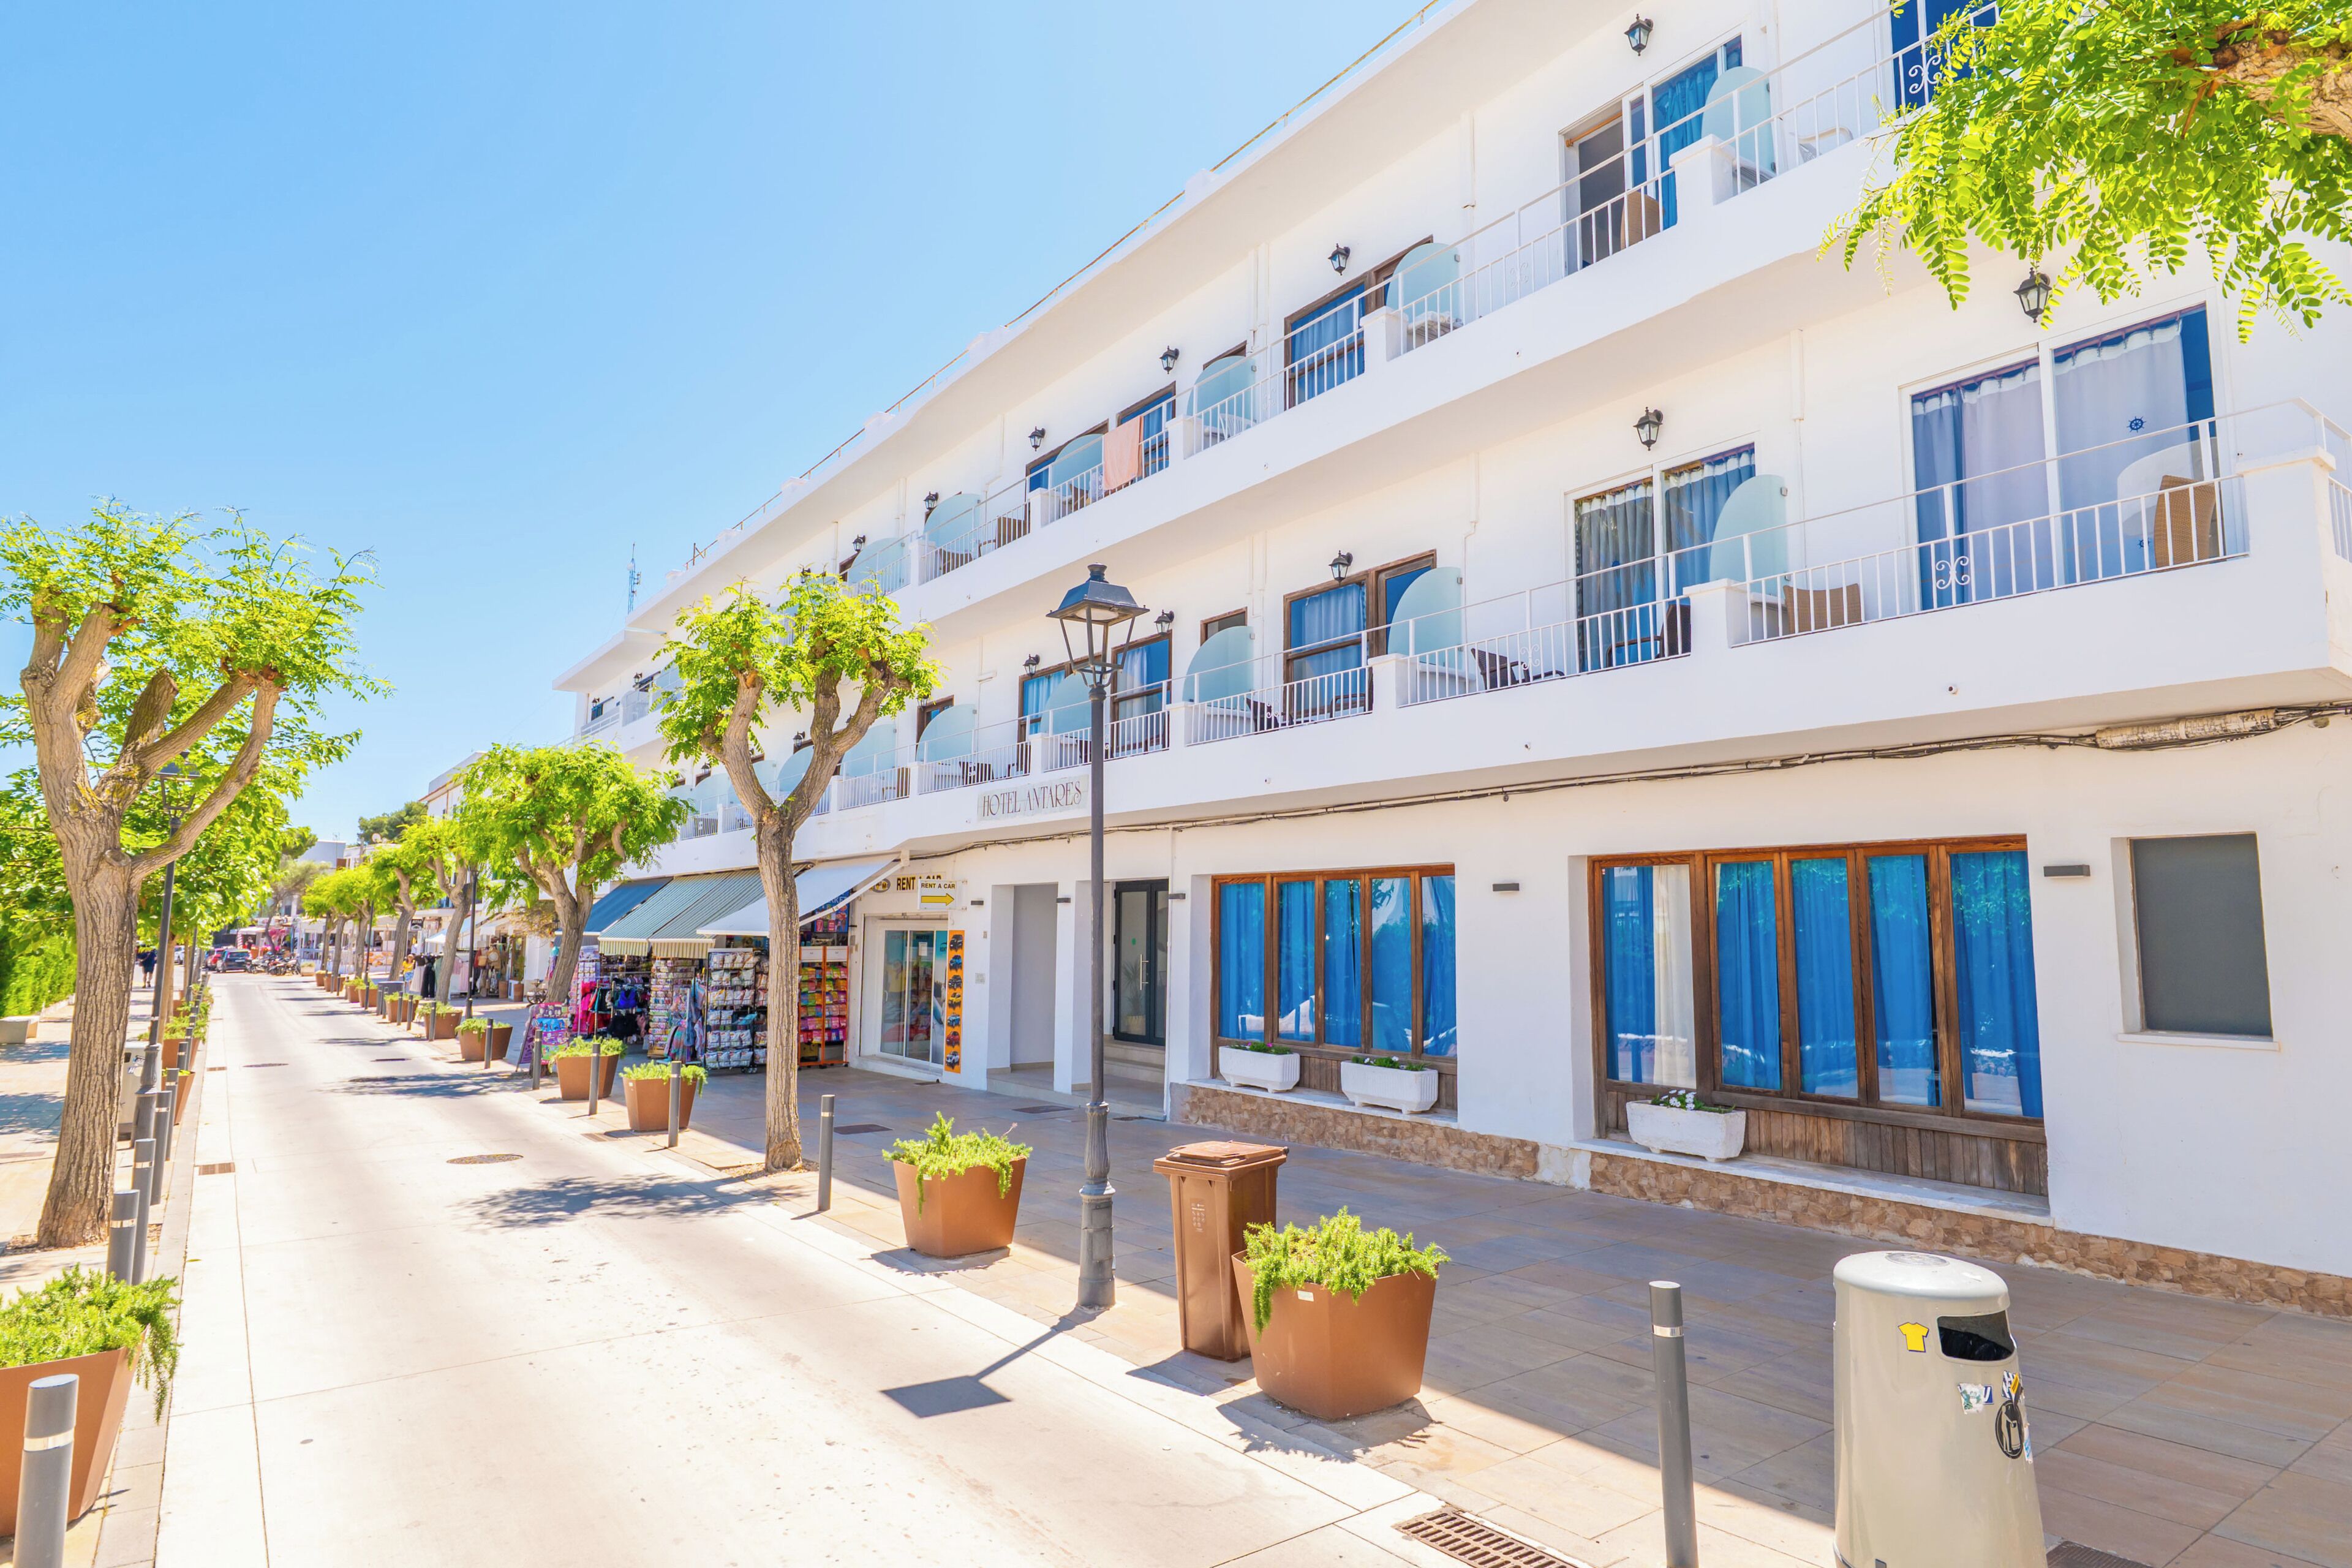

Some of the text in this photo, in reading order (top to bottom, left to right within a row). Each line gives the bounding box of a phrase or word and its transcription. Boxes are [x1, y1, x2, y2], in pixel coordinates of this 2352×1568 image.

[982, 781, 1082, 817] HOTEL ANTARES
[896, 876, 916, 891] RENT
